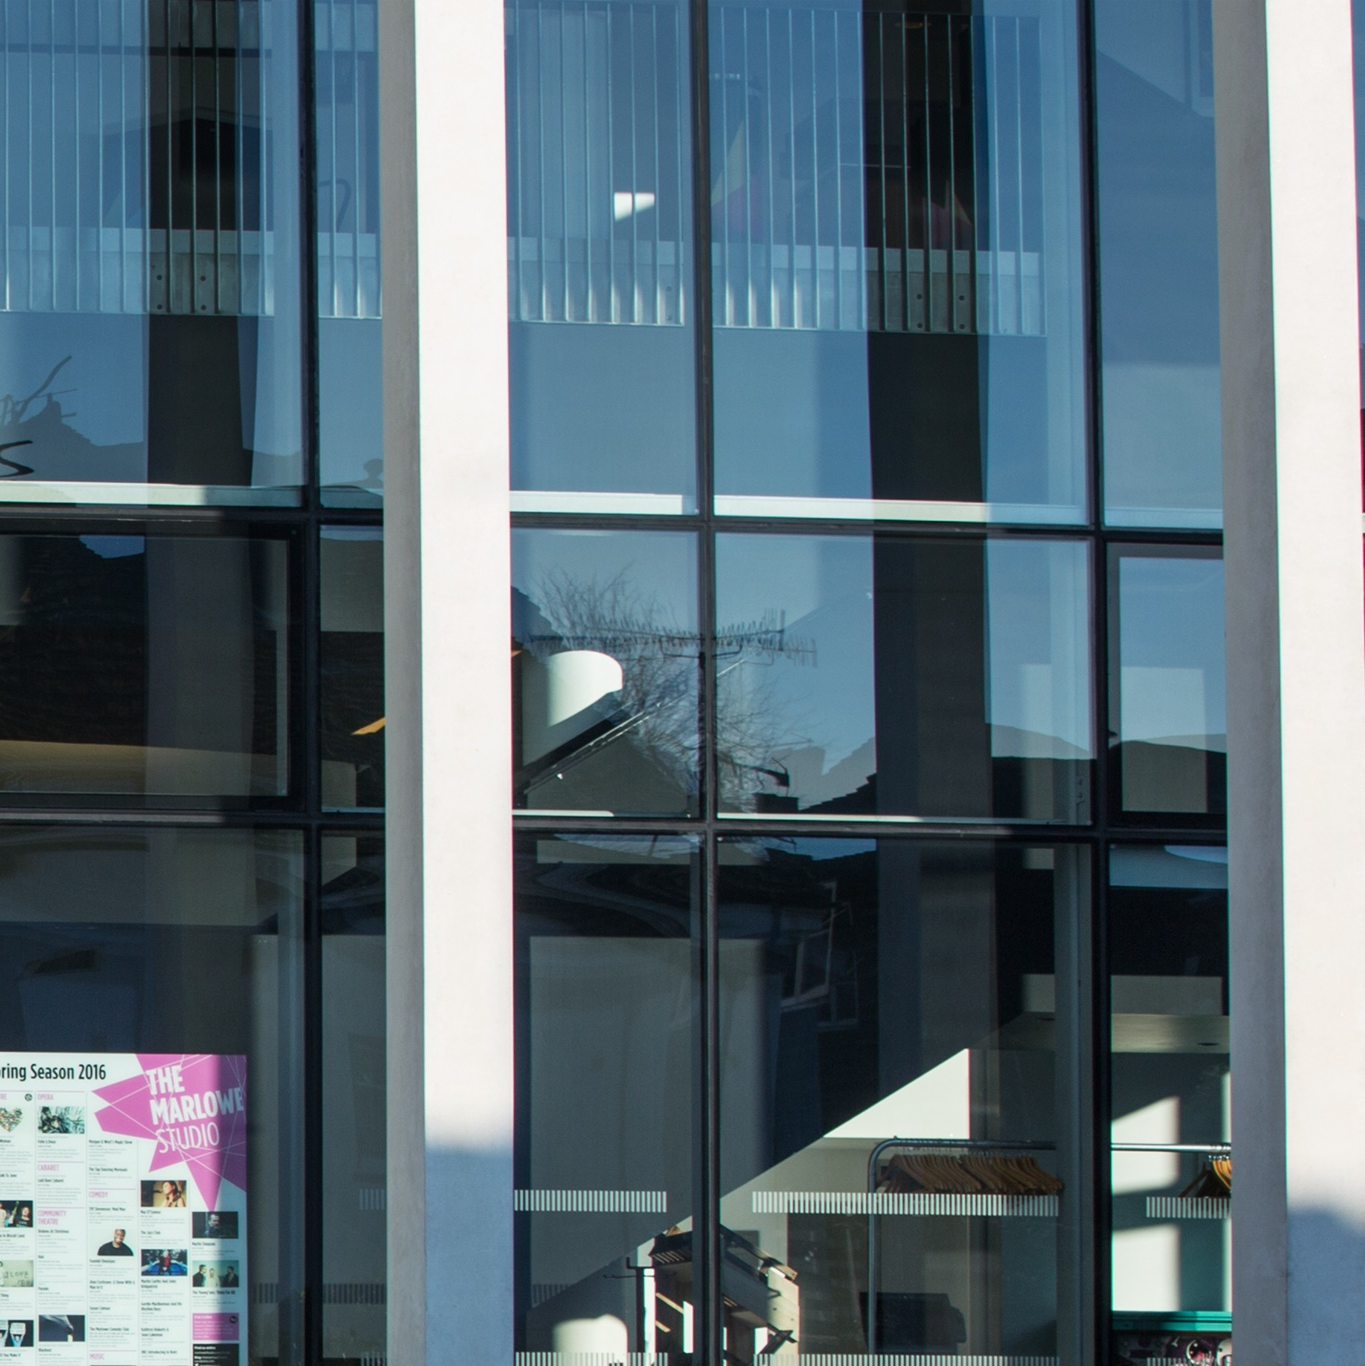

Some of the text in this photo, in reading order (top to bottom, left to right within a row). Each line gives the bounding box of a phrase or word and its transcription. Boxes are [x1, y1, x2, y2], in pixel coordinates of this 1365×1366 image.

[30, 1063, 75, 1080] Season
[78, 1064, 107, 1080] 2016
[145, 1065, 185, 1096] THE
[37, 1093, 54, 1101] OPERA
[149, 1087, 244, 1126] MARLOWE
[155, 1122, 220, 1154] STUDIO
[38, 1164, 60, 1172] CABARET
[88, 1191, 109, 1199] COMEDY
